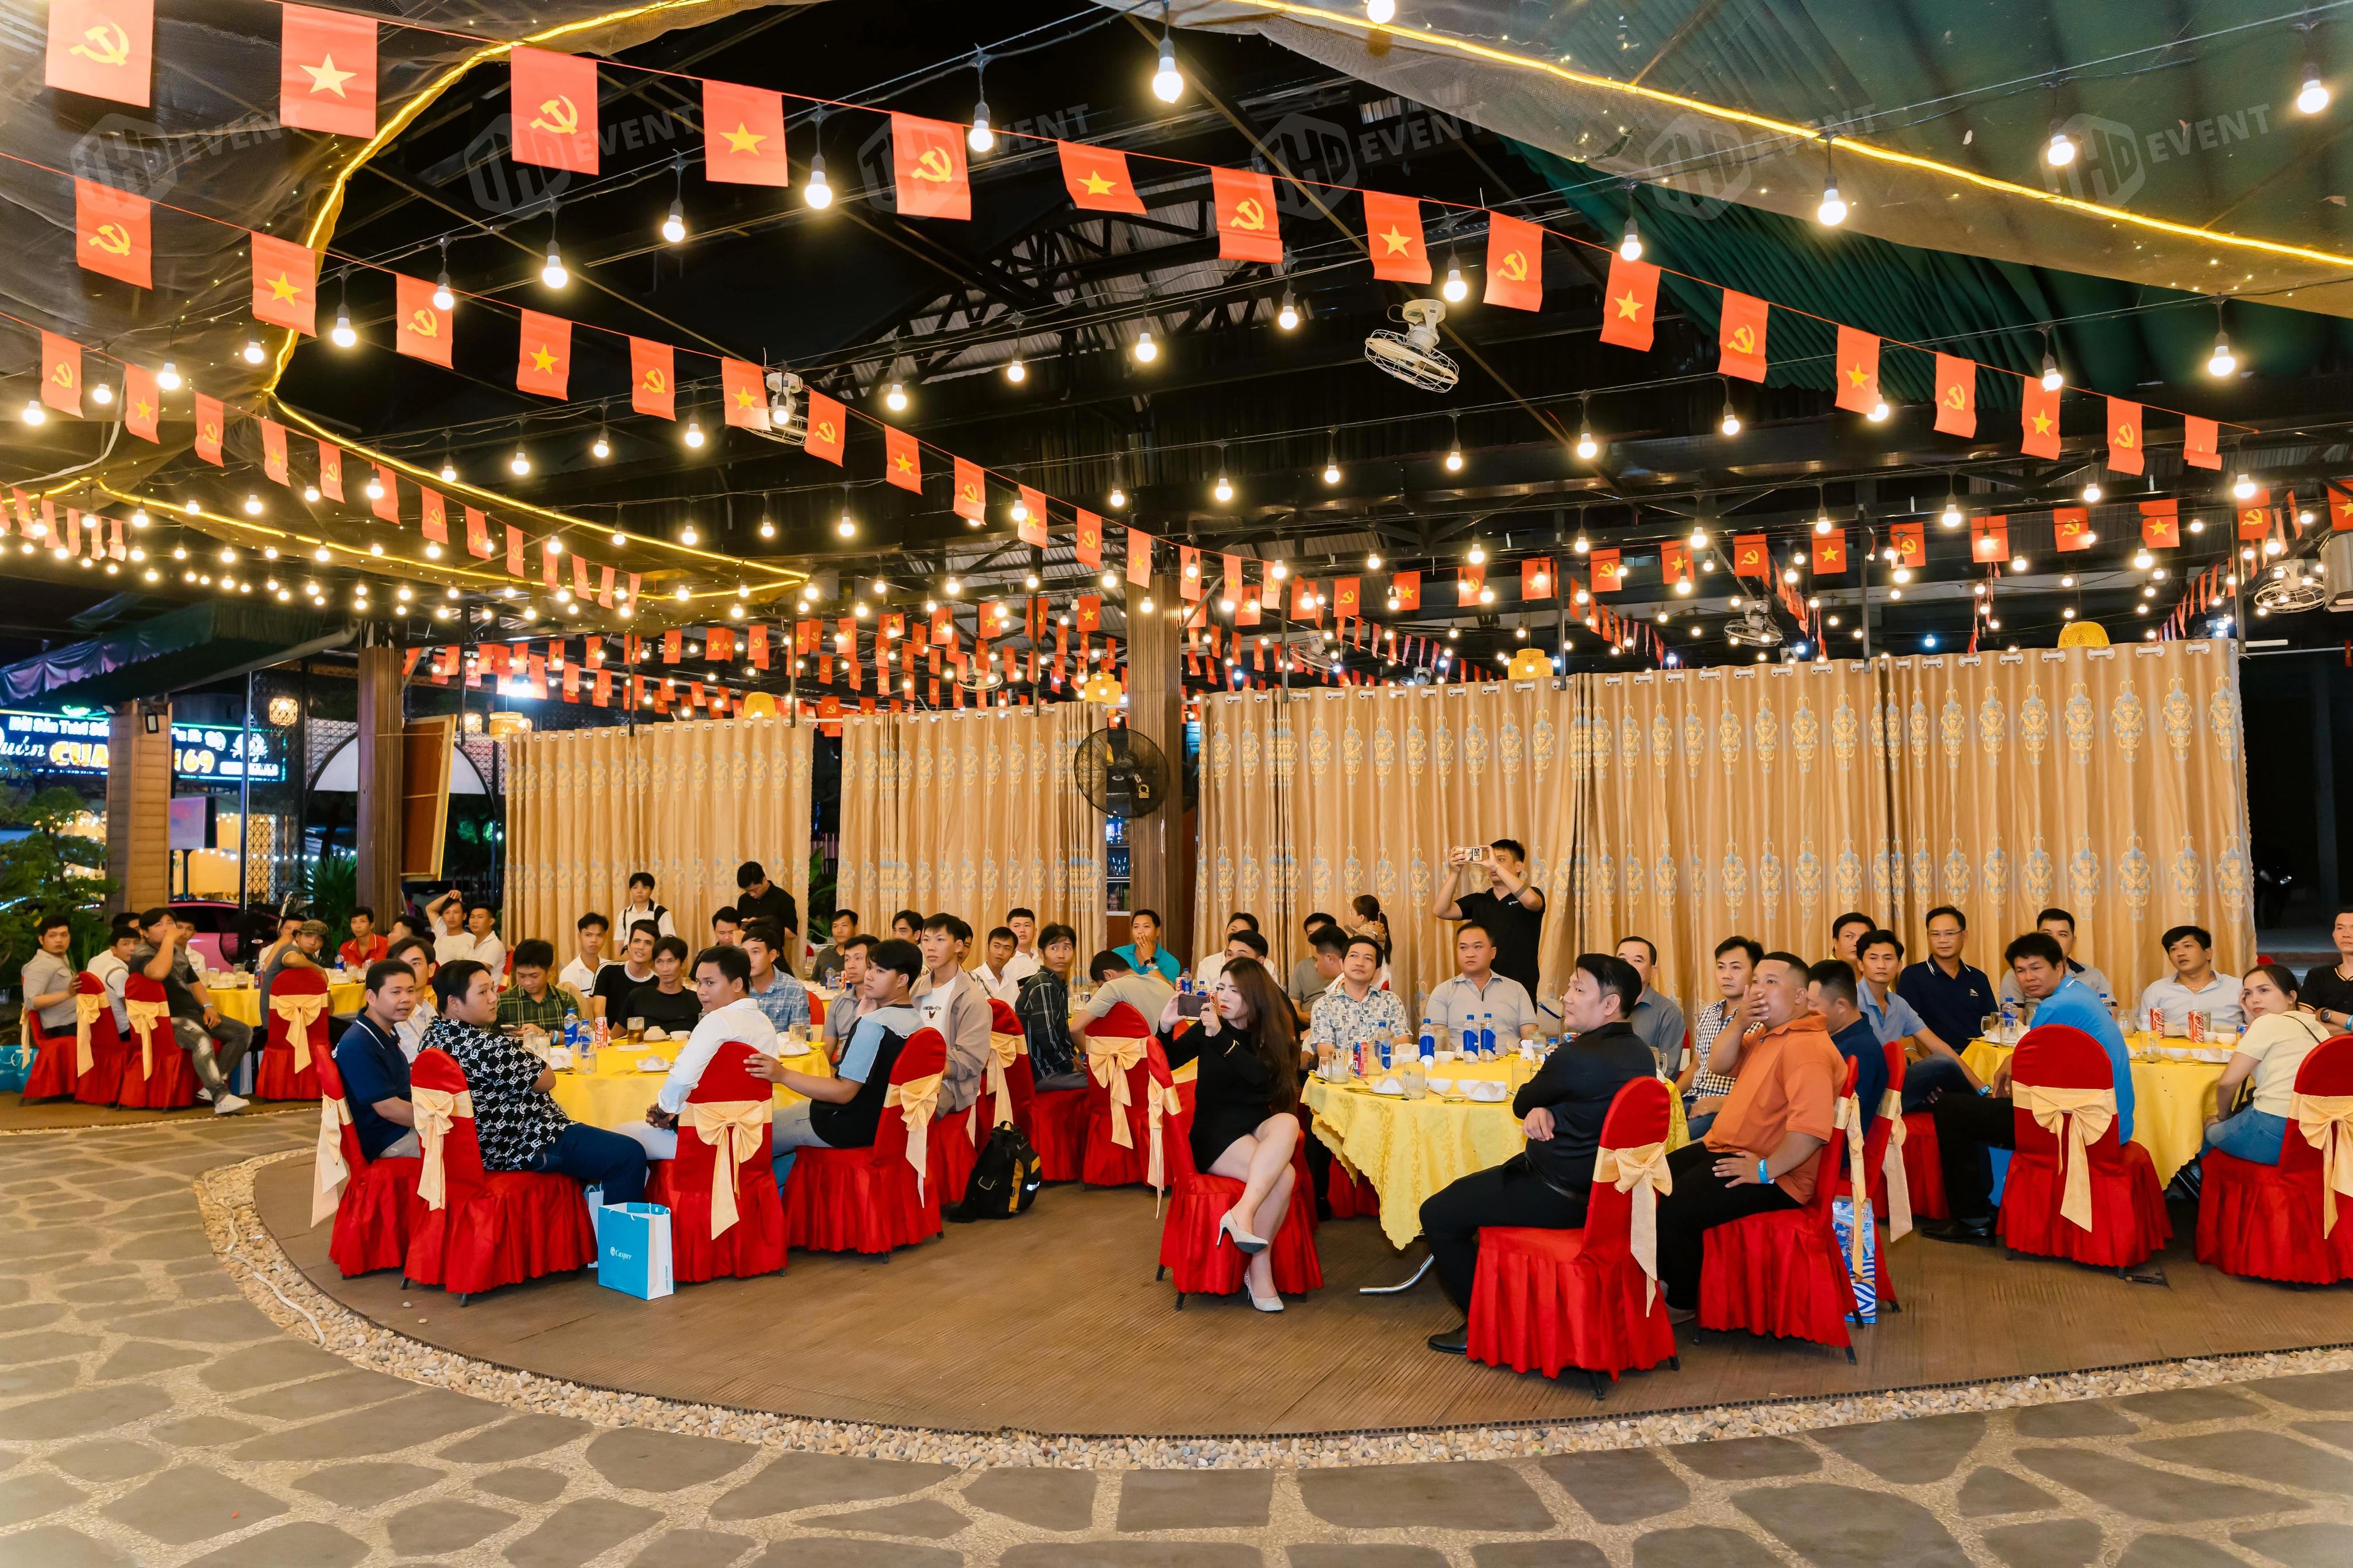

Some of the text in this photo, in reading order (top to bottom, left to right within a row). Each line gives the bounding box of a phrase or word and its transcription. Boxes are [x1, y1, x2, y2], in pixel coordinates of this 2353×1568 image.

[49, 741, 109, 768] CUA
[174, 748, 215, 773] 169
[615, 1249, 631, 1260] Casper
